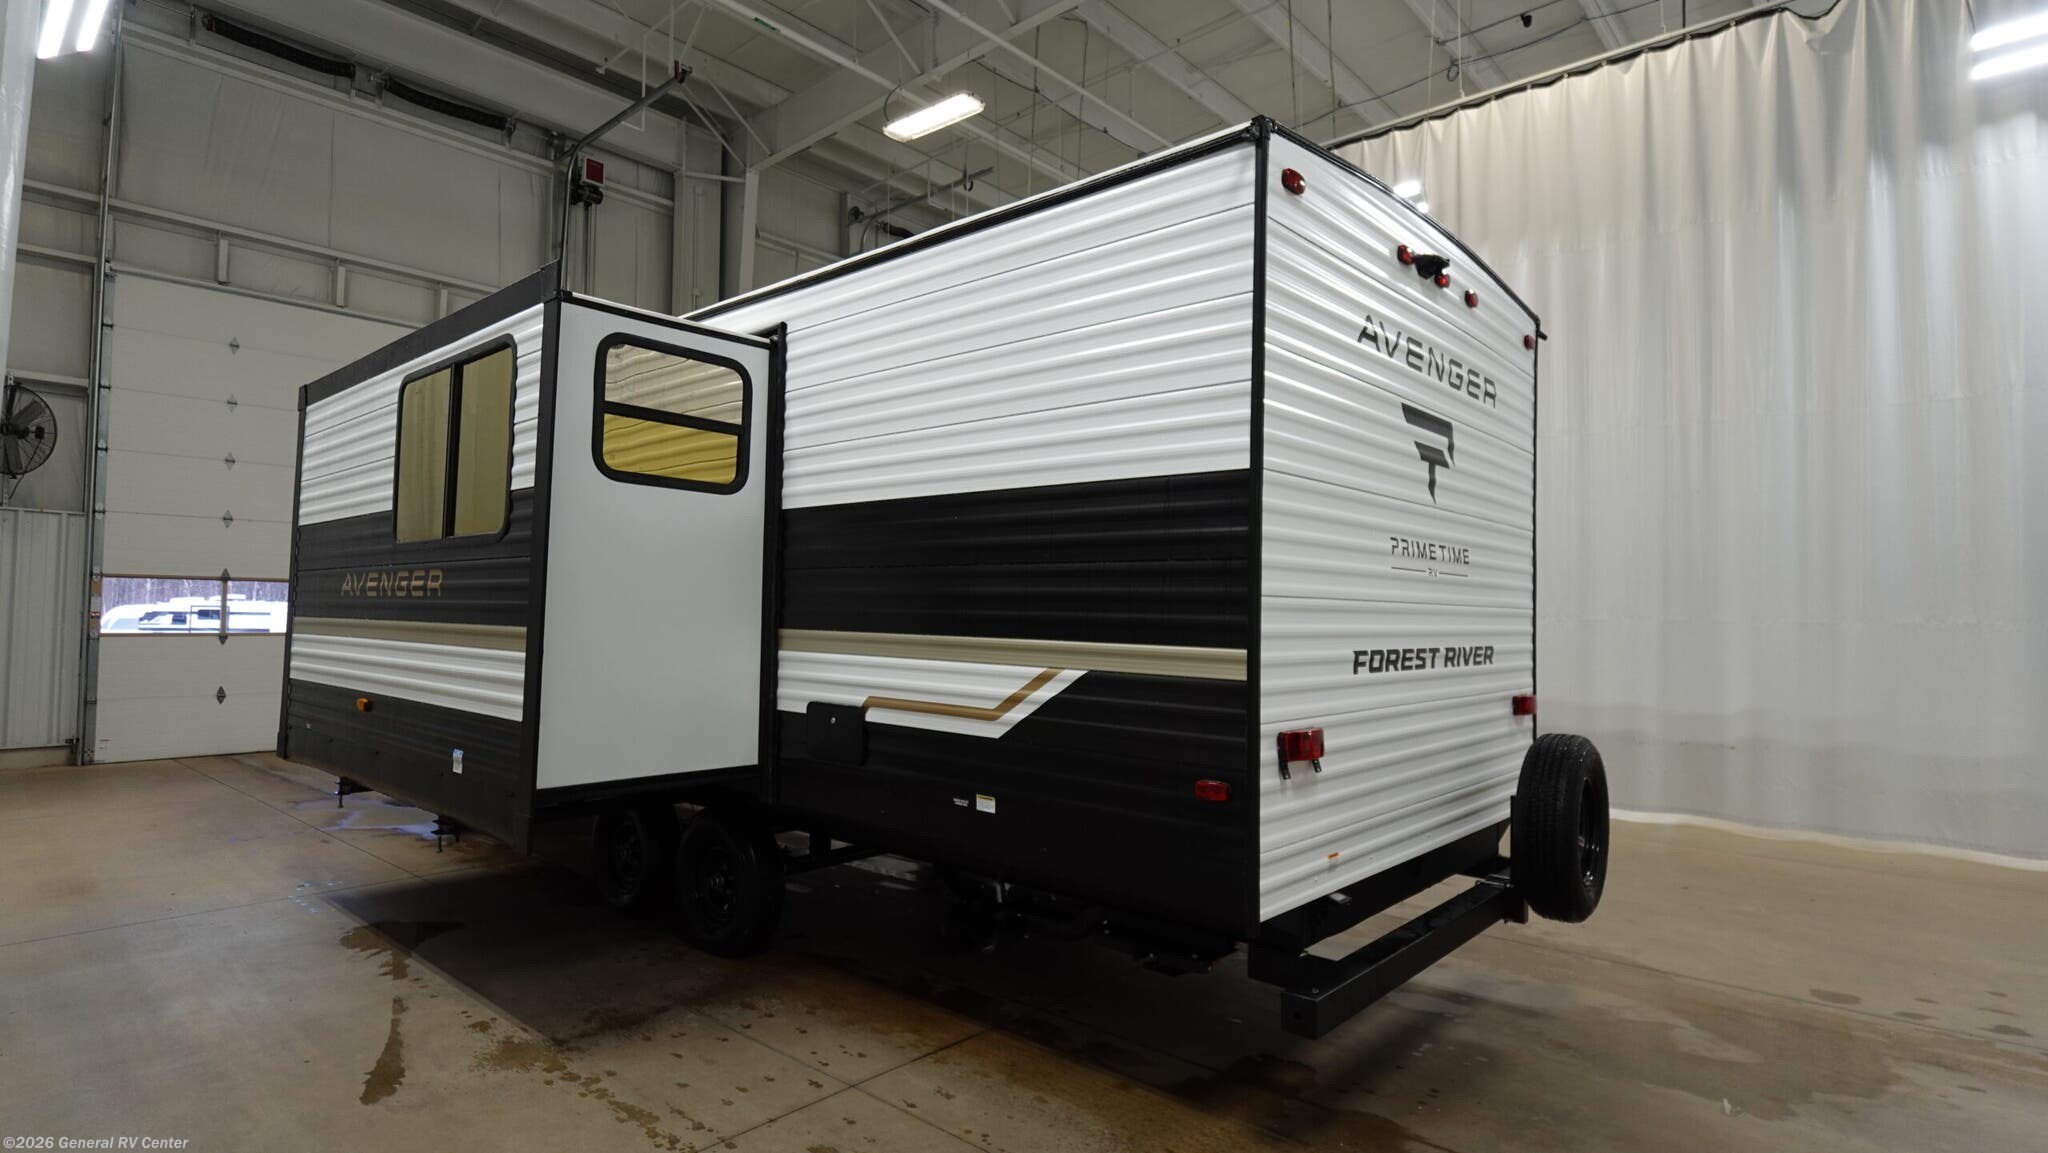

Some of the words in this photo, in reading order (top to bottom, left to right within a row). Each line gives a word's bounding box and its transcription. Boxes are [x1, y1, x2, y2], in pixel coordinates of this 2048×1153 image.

[1358, 314, 1497, 409] AVENGER
[341, 569, 443, 597] AVENGER
[1353, 647, 1440, 675] FOREST
[1444, 645, 1494, 668] RIVER
